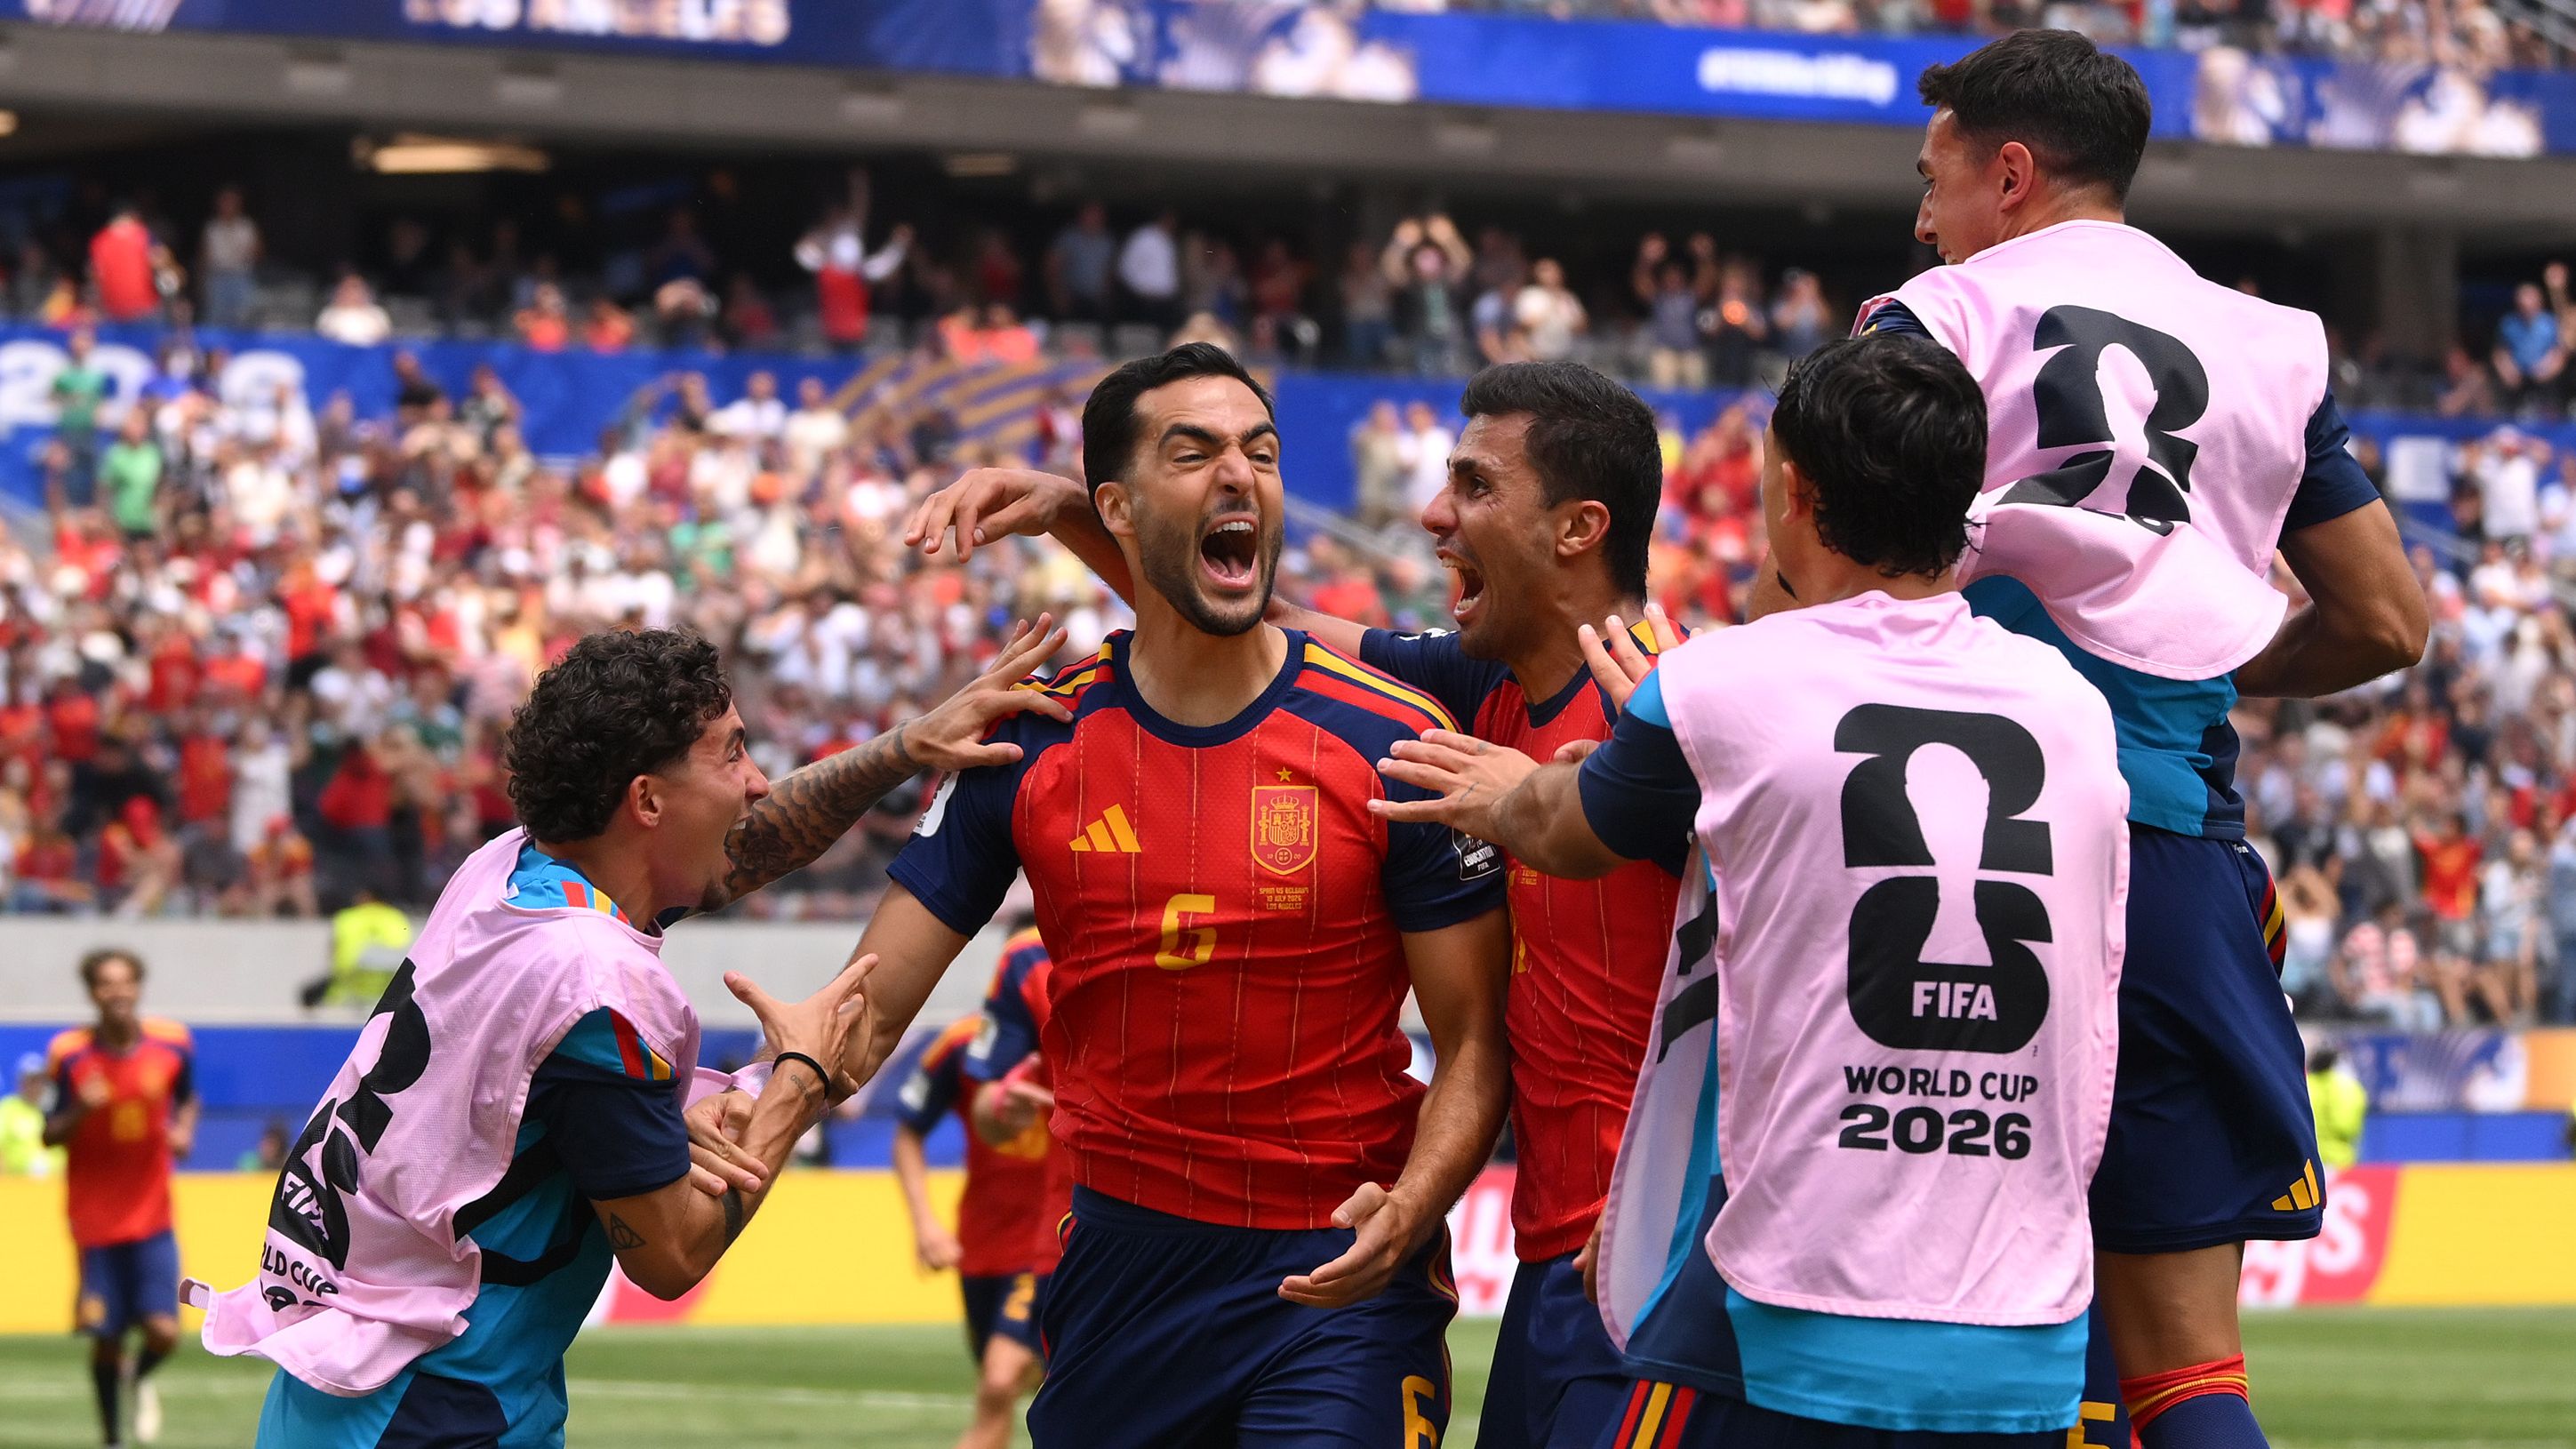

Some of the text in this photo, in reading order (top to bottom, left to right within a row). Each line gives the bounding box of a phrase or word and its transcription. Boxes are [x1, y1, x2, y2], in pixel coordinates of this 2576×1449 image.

[1477, 861, 1490, 871] FIFA
[1155, 893, 1217, 971] 6
[1912, 981, 1997, 1021] FIFA
[1844, 1066, 2038, 1102] WORLD CUP
[1837, 1103, 2032, 1161] 2026
[291, 1261, 339, 1298] CUP
